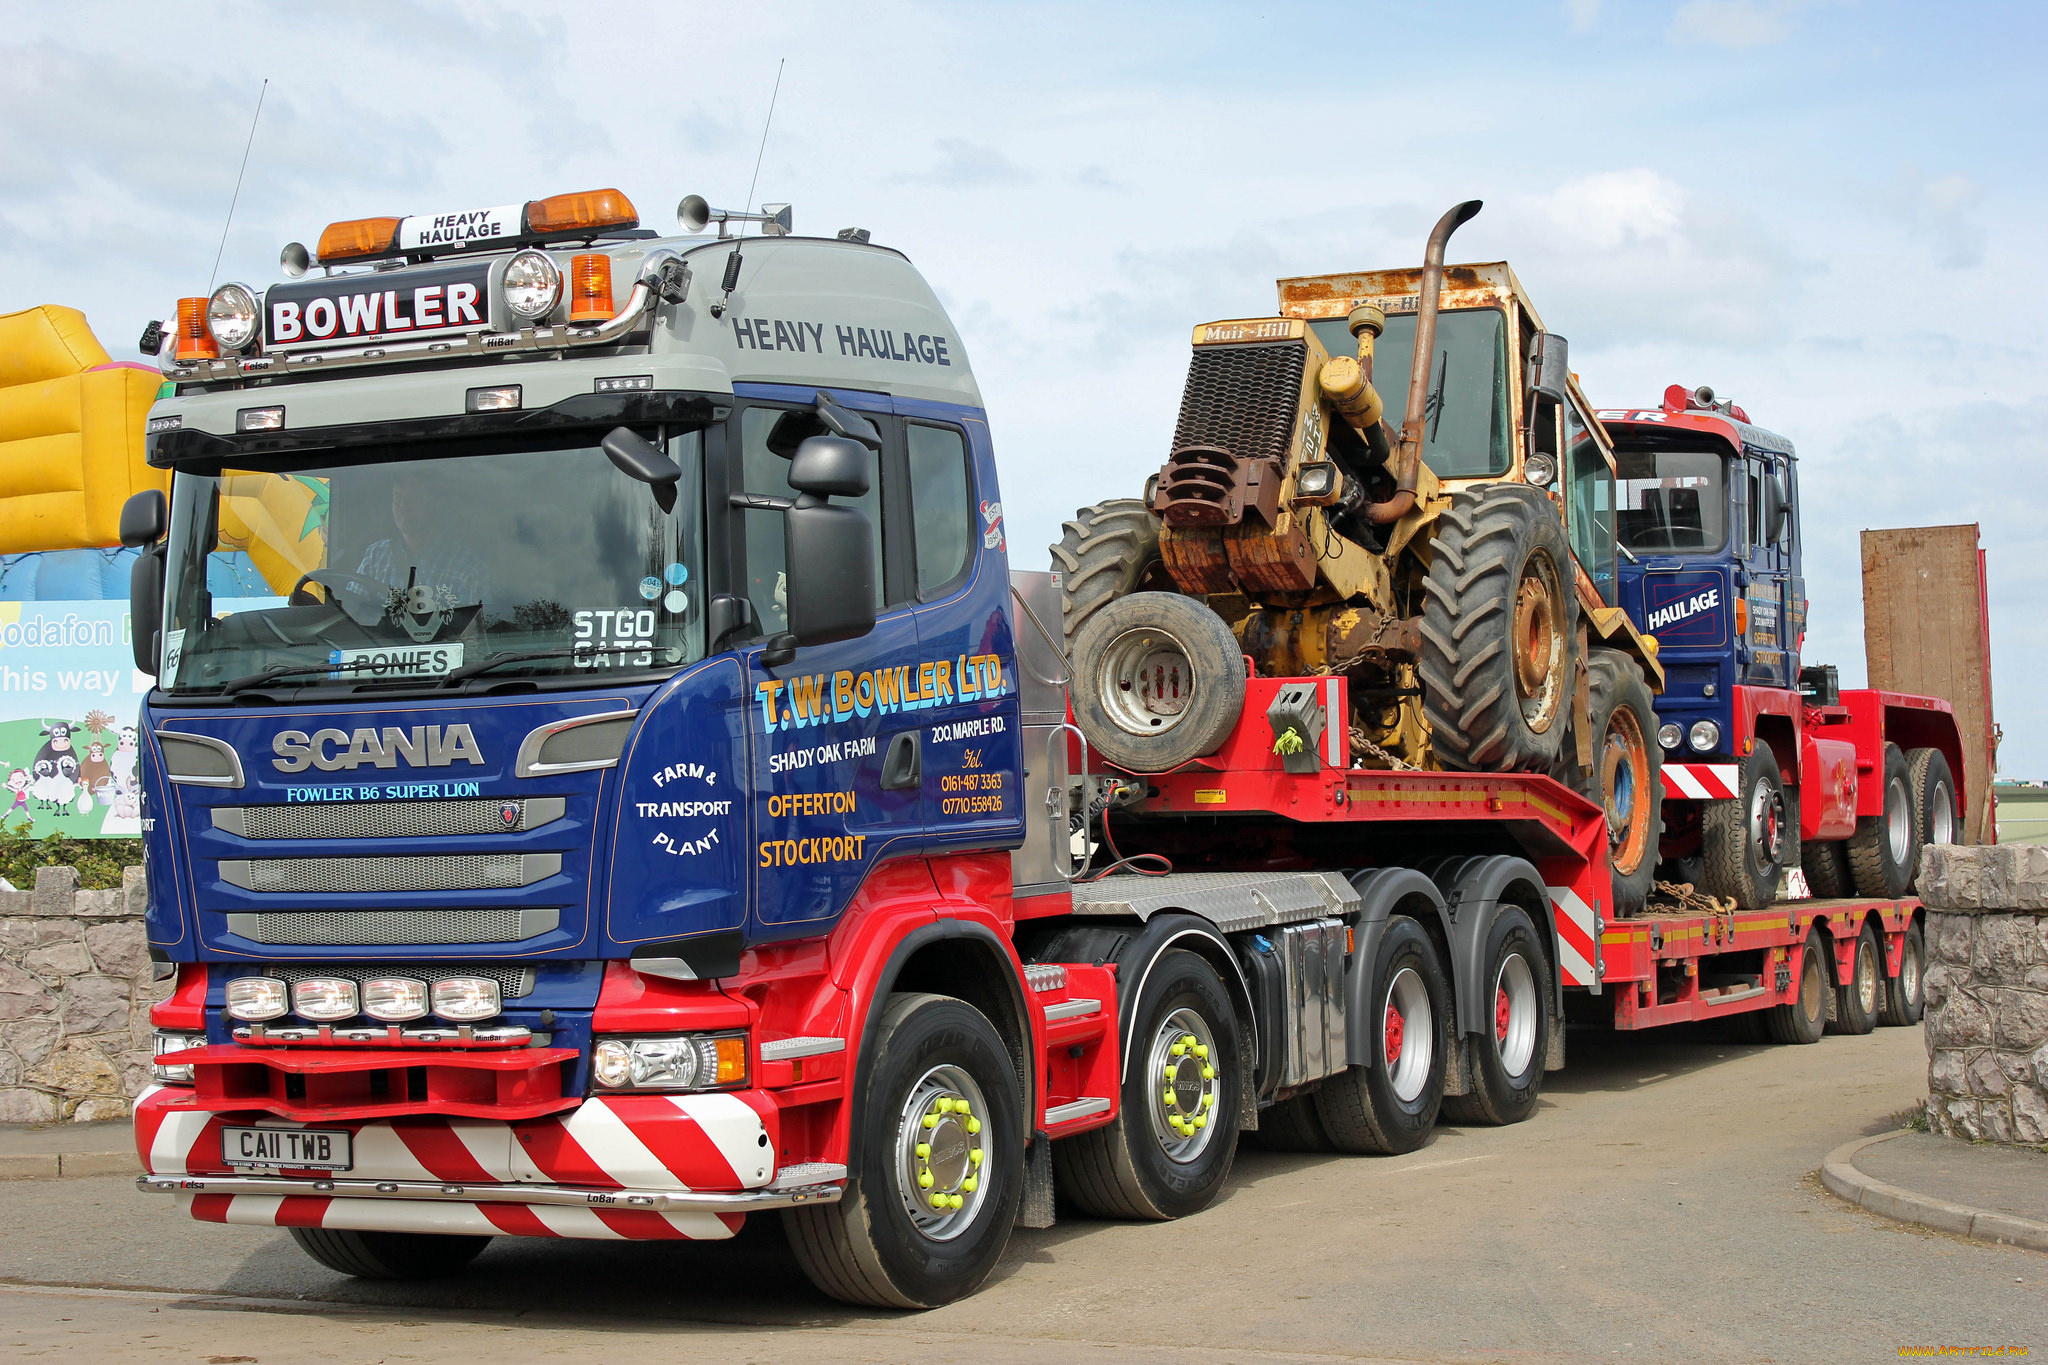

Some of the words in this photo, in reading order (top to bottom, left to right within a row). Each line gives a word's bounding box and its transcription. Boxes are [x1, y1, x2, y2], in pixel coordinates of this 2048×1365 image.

[419, 221, 501, 245] HAULAGE
[433, 210, 491, 230] HEAVY
[272, 282, 481, 344] BOWLER
[487, 337, 516, 348] HiBar
[732, 317, 824, 354] HEAVY
[836, 324, 951, 367] HAULAGE
[243, 360, 269, 372] Kelsa
[1648, 588, 1720, 631] HAULAGE
[0, 613, 114, 647] odafon
[574, 610, 655, 638] STGO
[354, 650, 448, 677] PONIES
[956, 653, 1007, 701] LTD.
[0, 664, 48, 691] his
[58, 669, 120, 697] way
[953, 718, 990, 741] MARPLE
[991, 715, 1007, 734] RD.
[271, 723, 486, 773] SCANIA
[769, 747, 815, 774] SHADY
[816, 743, 842, 765] OAK
[844, 736, 876, 758] FARM
[961, 748, 984, 769] Tel.
[652, 762, 705, 788] FARM
[705, 770, 717, 787] &
[981, 773, 1003, 790] 3363
[287, 786, 354, 802] FOWLER
[359, 785, 380, 801] B6
[385, 783, 440, 799] SUPER
[444, 781, 480, 798] LION
[768, 791, 856, 818] OFFERTON
[942, 797, 970, 815] 07710
[971, 795, 1003, 813] 558426
[636, 801, 732, 818] TRANSPORT
[652, 828, 721, 856] PLANT
[759, 834, 866, 868] STOCKPORT
[240, 1131, 281, 1159] CA11
[286, 1133, 331, 1161] TWB
[180, 1180, 205, 1189] Kelsa
[586, 1193, 617, 1204] LoBar
